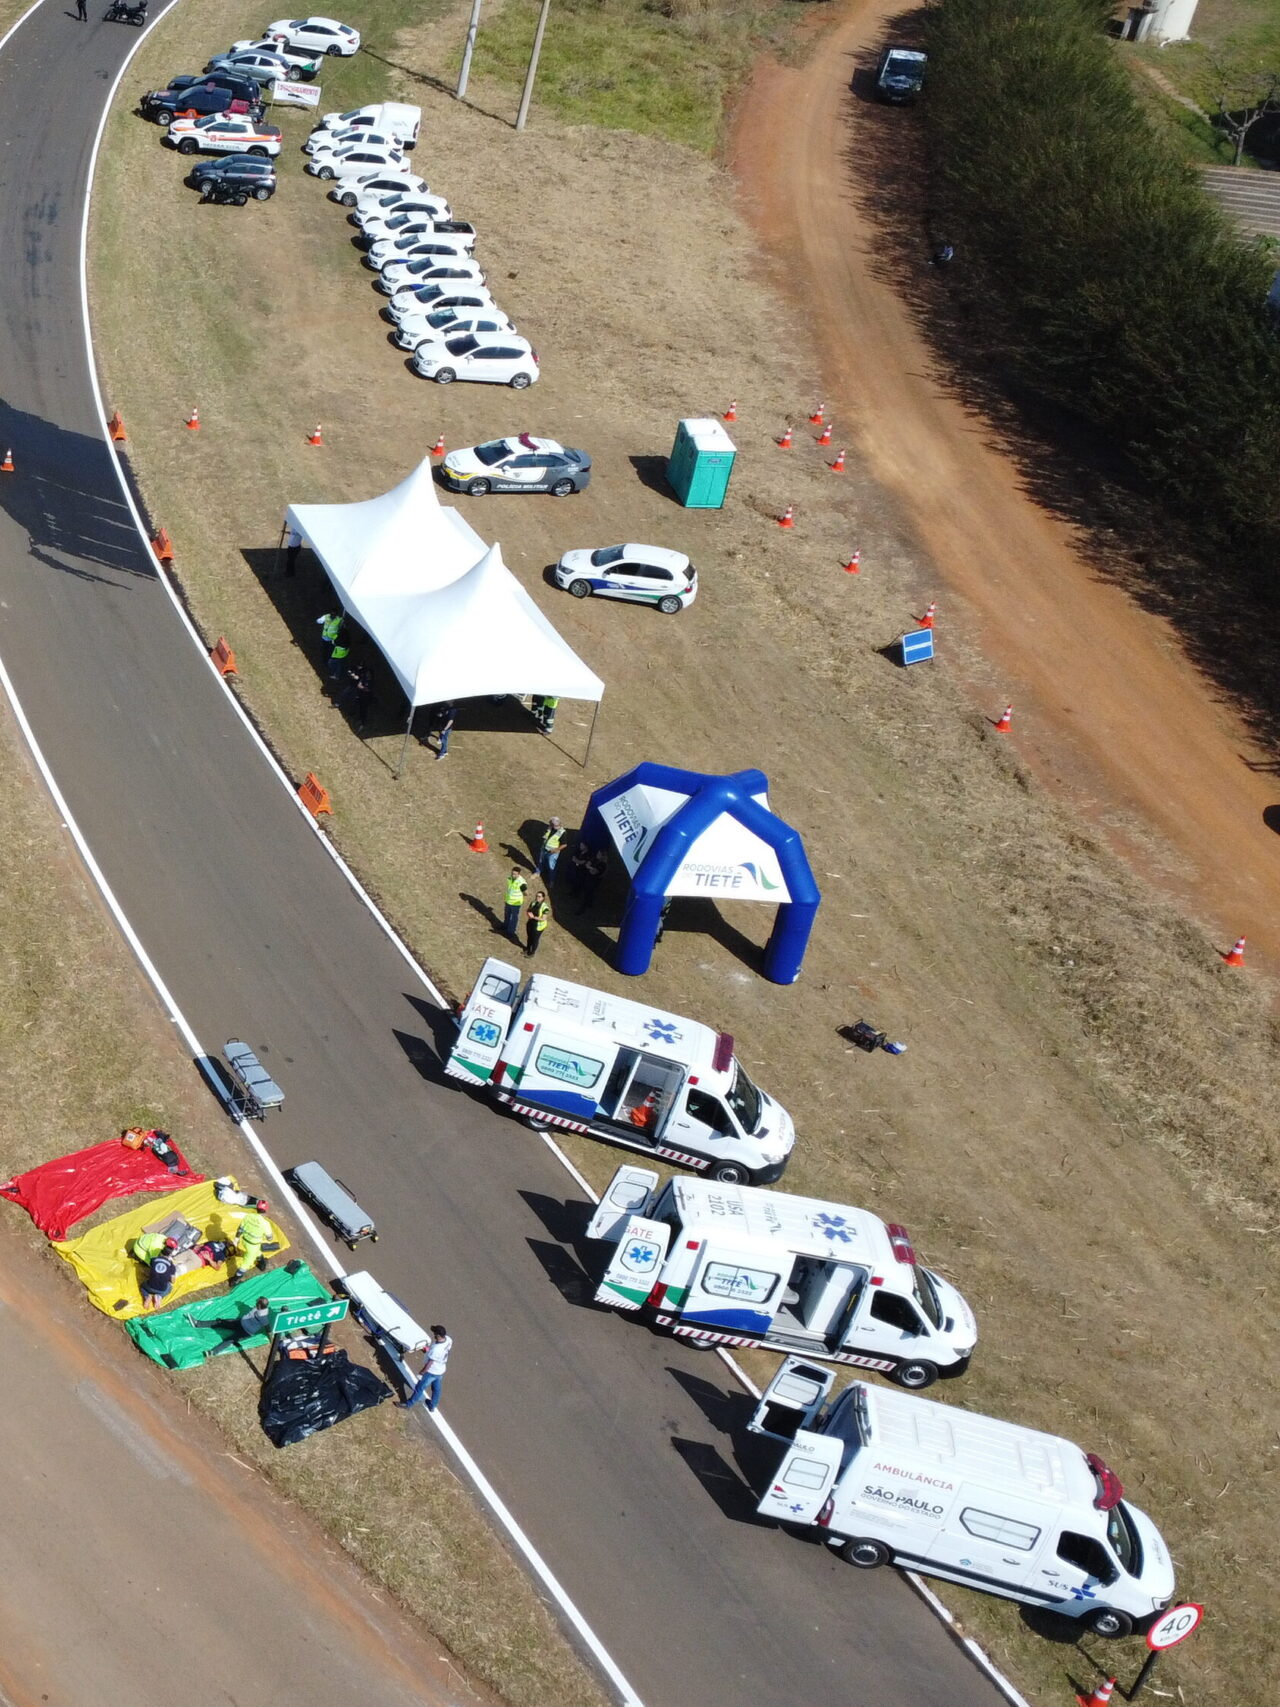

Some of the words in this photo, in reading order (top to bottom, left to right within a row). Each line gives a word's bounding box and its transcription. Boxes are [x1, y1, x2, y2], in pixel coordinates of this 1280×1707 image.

[614, 809, 638, 843] TIETÊ
[682, 863, 735, 873] RODOVIAS
[695, 872, 743, 888] TIETÊ
[471, 1004, 496, 1018] ATE
[286, 1310, 322, 1326] Tietê
[873, 1463, 954, 1491] AMBULÂNCIA
[860, 1493, 898, 1507] GOVERNO
[898, 1503, 910, 1511] DO
[910, 1507, 942, 1520] ESTADO
[863, 1485, 895, 1500] SÃO
[896, 1496, 944, 1515] PAULO
[1047, 1579, 1070, 1591] SUS
[1160, 1614, 1192, 1634] 40
